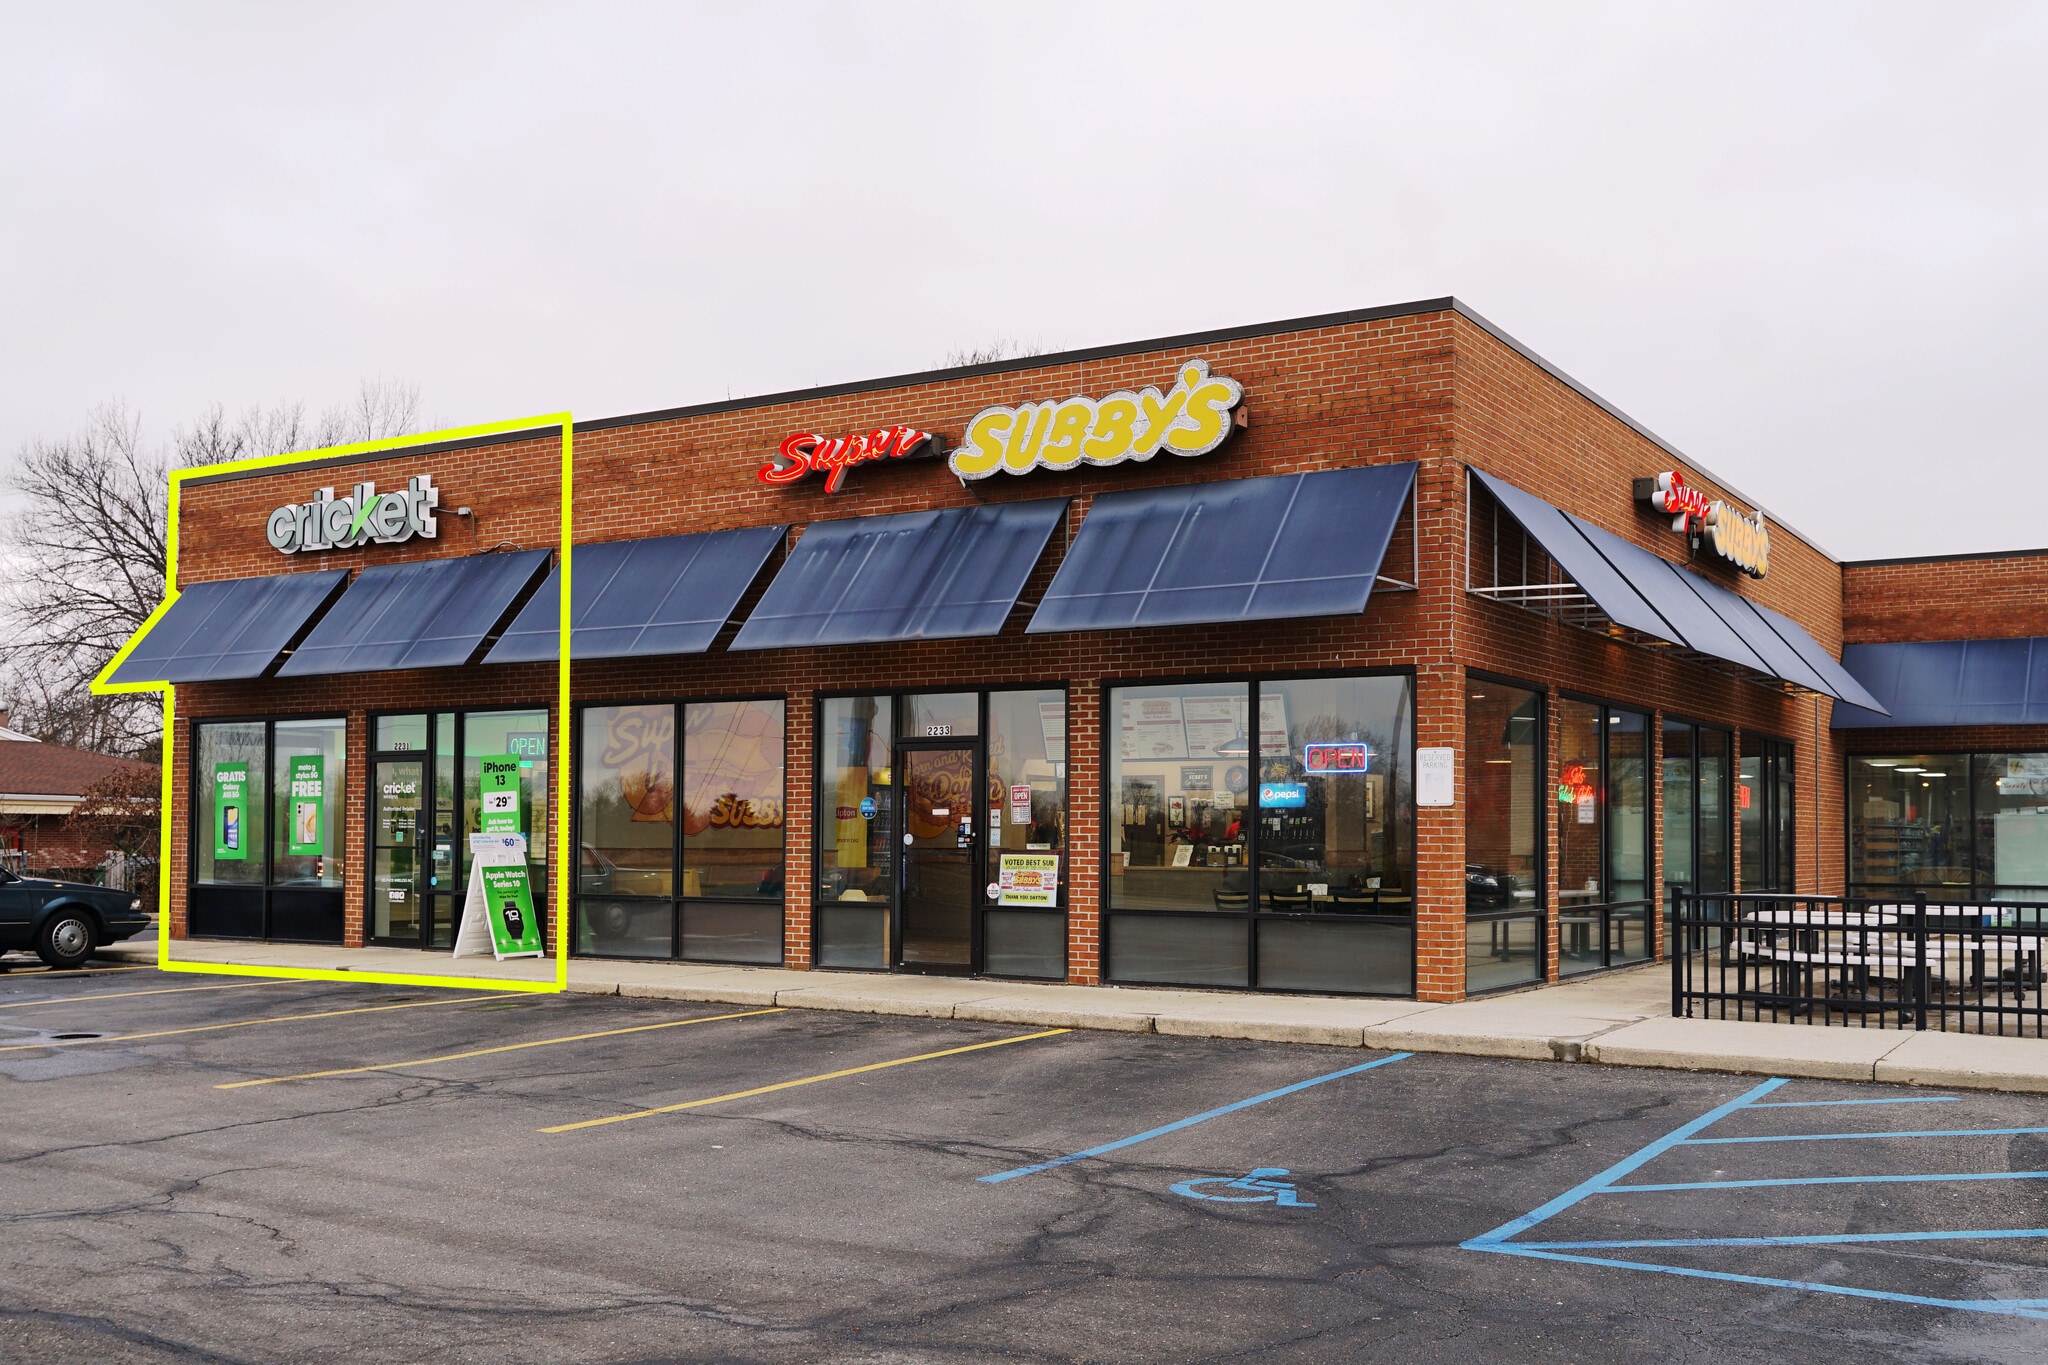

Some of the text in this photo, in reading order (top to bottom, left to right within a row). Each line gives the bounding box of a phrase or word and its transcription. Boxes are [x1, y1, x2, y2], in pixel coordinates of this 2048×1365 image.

[757, 365, 1235, 494] Super SUBBY'S
[266, 476, 432, 551] cricket
[1714, 503, 1769, 577] SUBBY'S
[927, 726, 950, 735] 2233
[510, 738, 545, 755] OPEN
[602, 706, 714, 788] Supr
[1308, 748, 1364, 769] OPEN
[484, 762, 516, 773] iPhone
[217, 771, 246, 782] GRATIS
[495, 775, 506, 786] 13
[291, 781, 322, 797] FREE
[383, 782, 414, 793] cricket
[1014, 792, 1027, 800] OPEN
[1274, 790, 1299, 800] pepsi
[837, 809, 856, 818] ipton
[502, 838, 514, 846] $60
[486, 872, 504, 880] Apple
